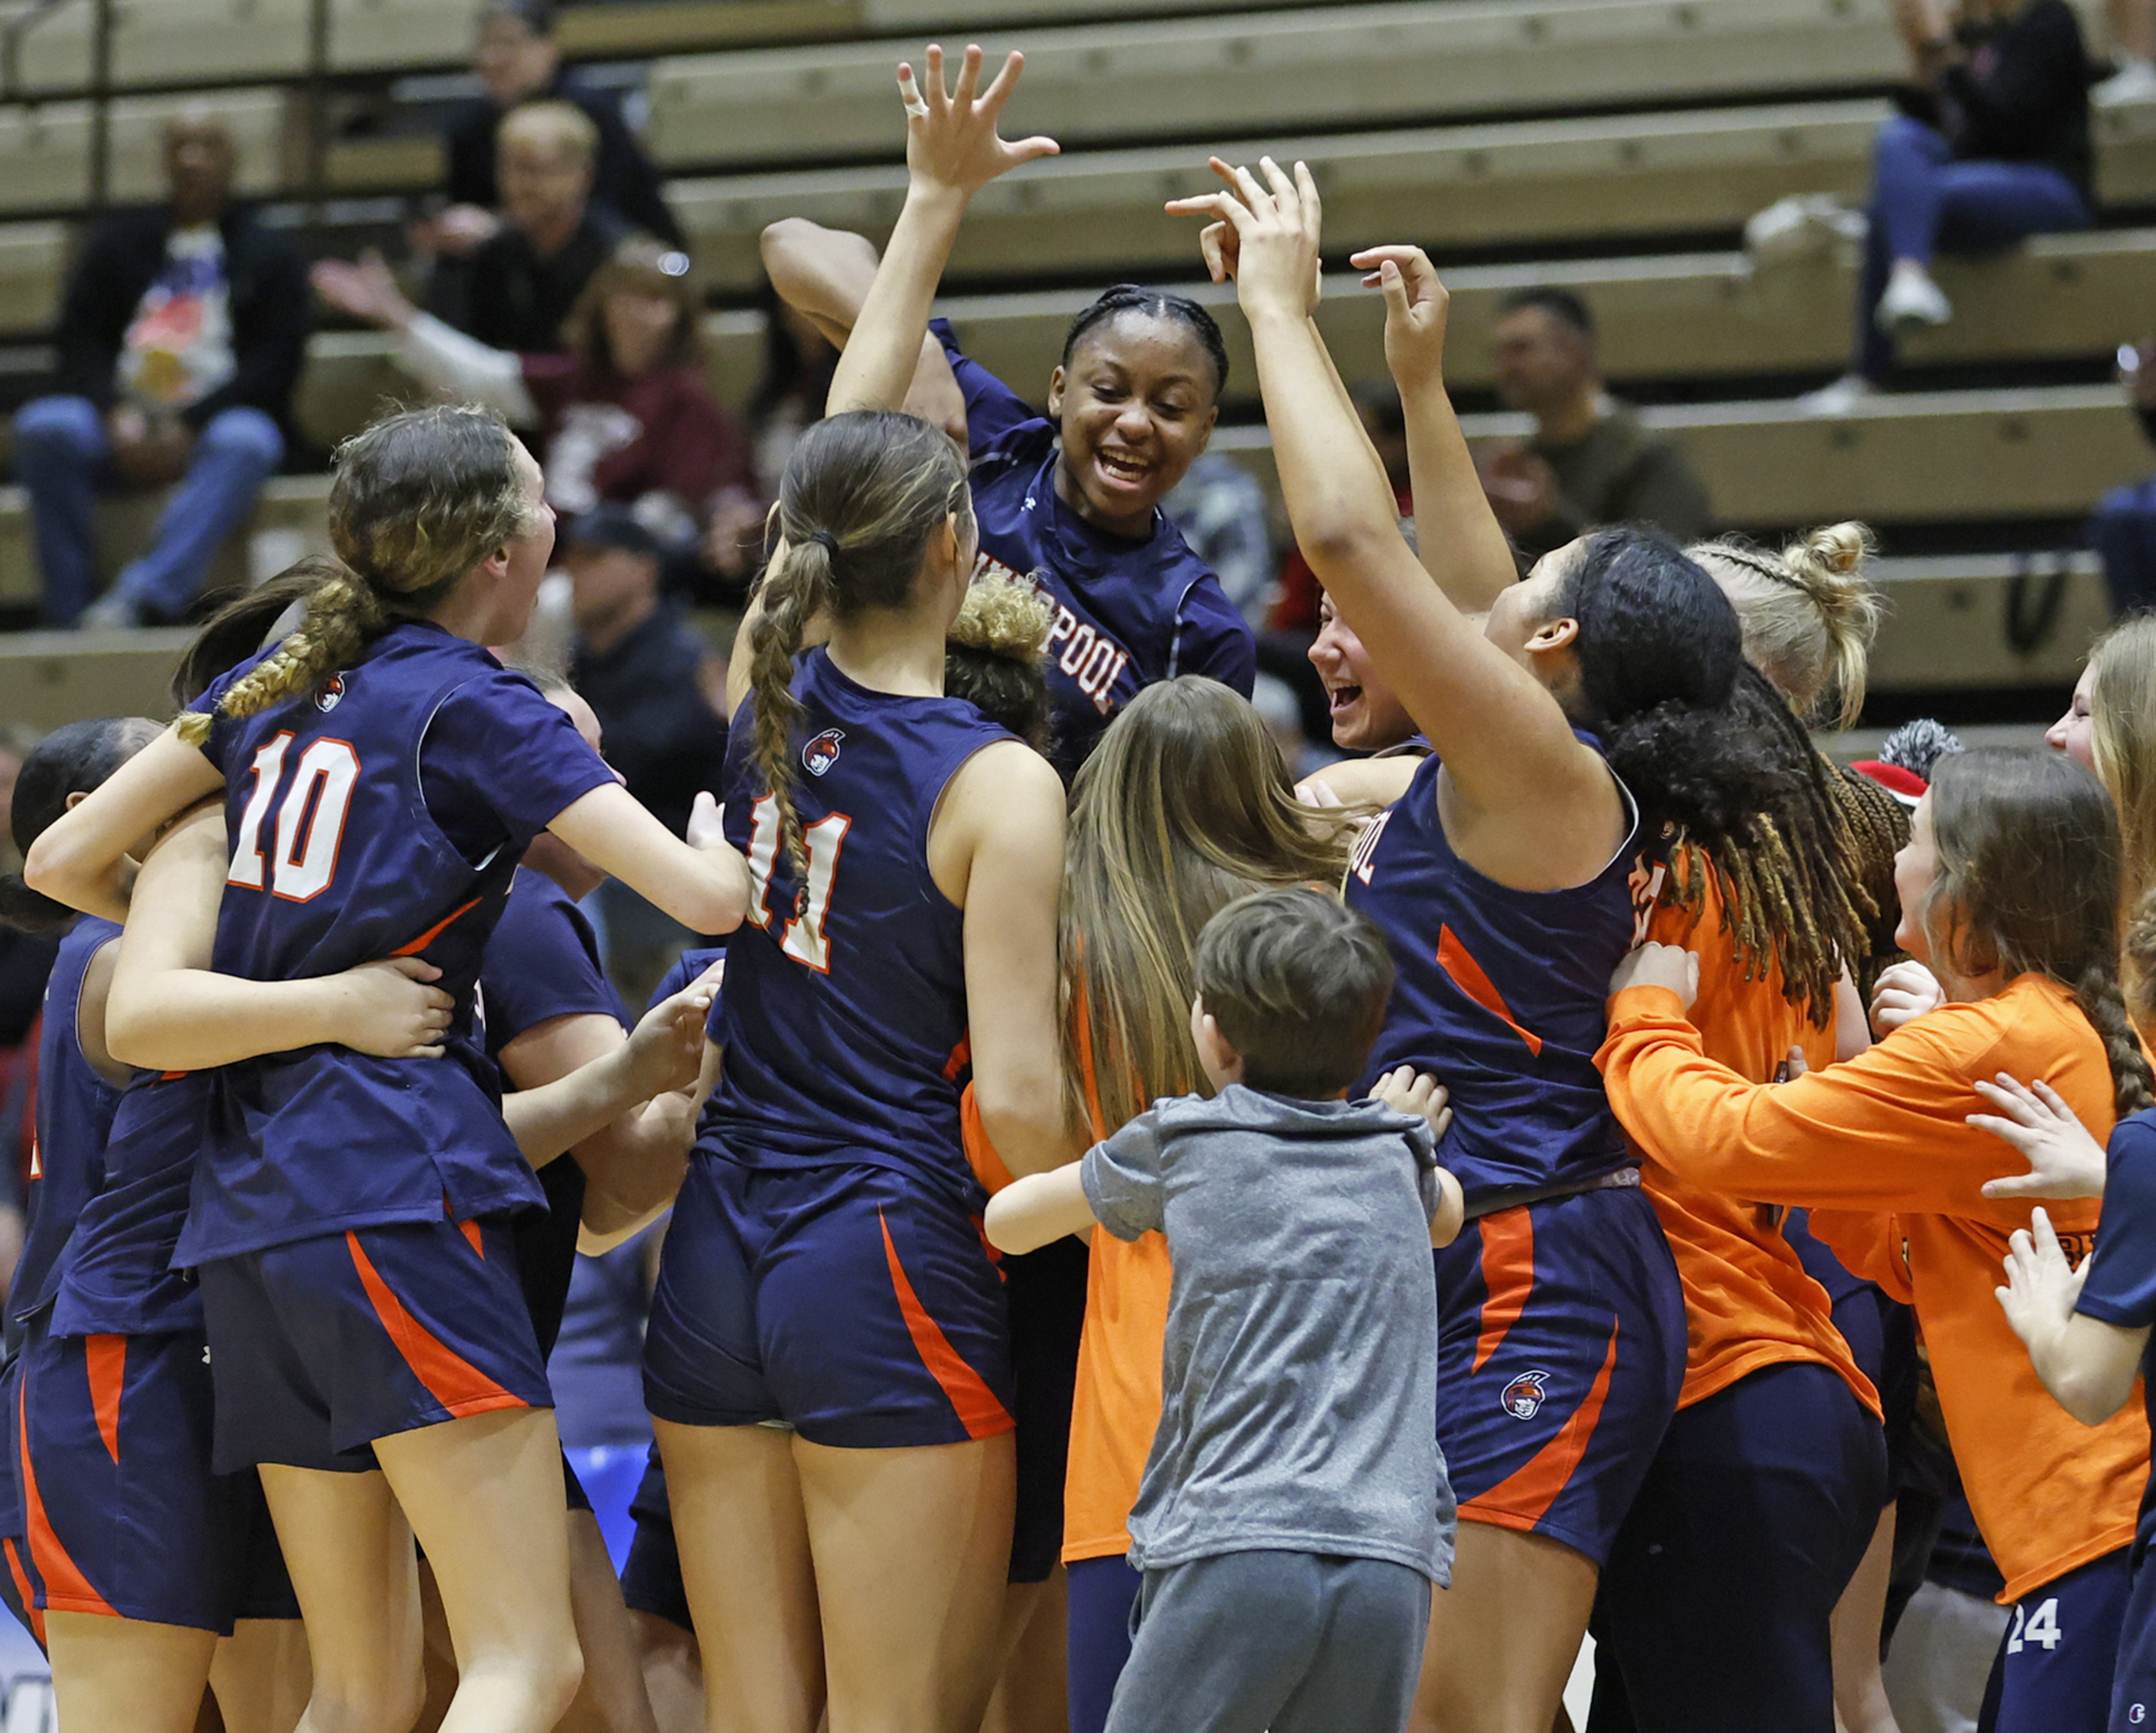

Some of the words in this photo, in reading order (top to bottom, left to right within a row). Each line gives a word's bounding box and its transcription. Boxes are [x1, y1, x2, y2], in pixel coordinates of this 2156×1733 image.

[226, 729, 362, 903] 10
[746, 789, 852, 975] 11
[2007, 1597, 2062, 1655] 24
